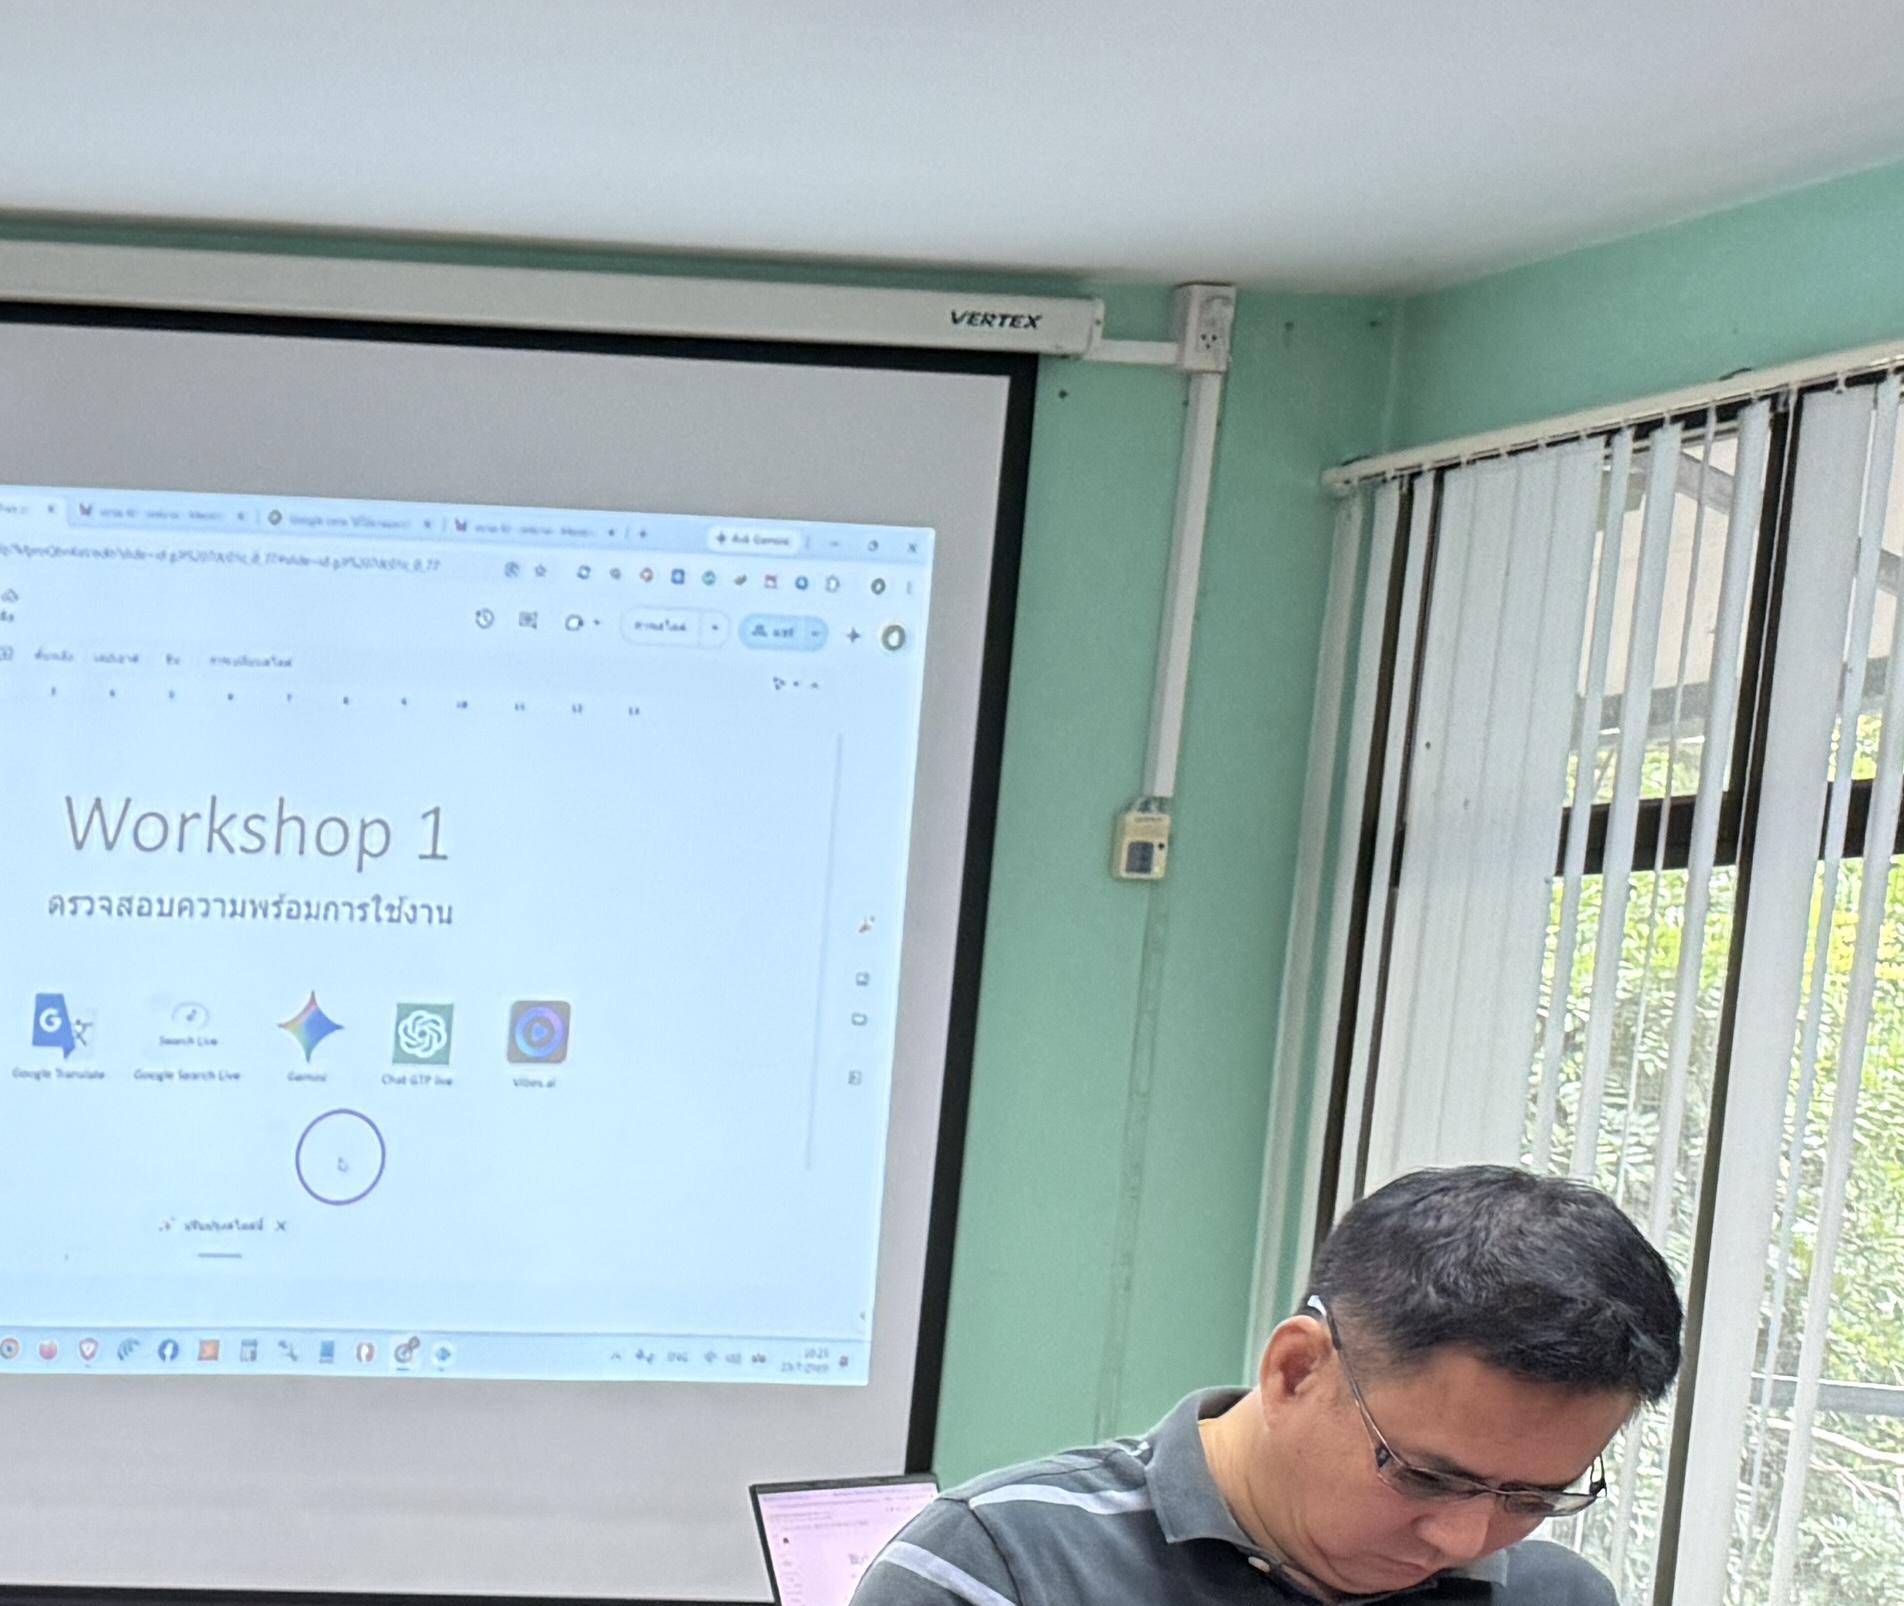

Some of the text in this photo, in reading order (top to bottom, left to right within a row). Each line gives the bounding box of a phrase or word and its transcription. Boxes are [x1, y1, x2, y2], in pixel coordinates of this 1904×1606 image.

[949, 308, 1043, 331] VERTEX
[64, 795, 449, 874] Workshop 1
[48, 891, 453, 926] ตรวจสอบความพร้อมการใช้งาน
[12, 1066, 52, 1081] Google
[133, 1068, 241, 1083] Google Search Live
[286, 1071, 327, 1083] Gemini
[381, 1073, 407, 1086] Chat
